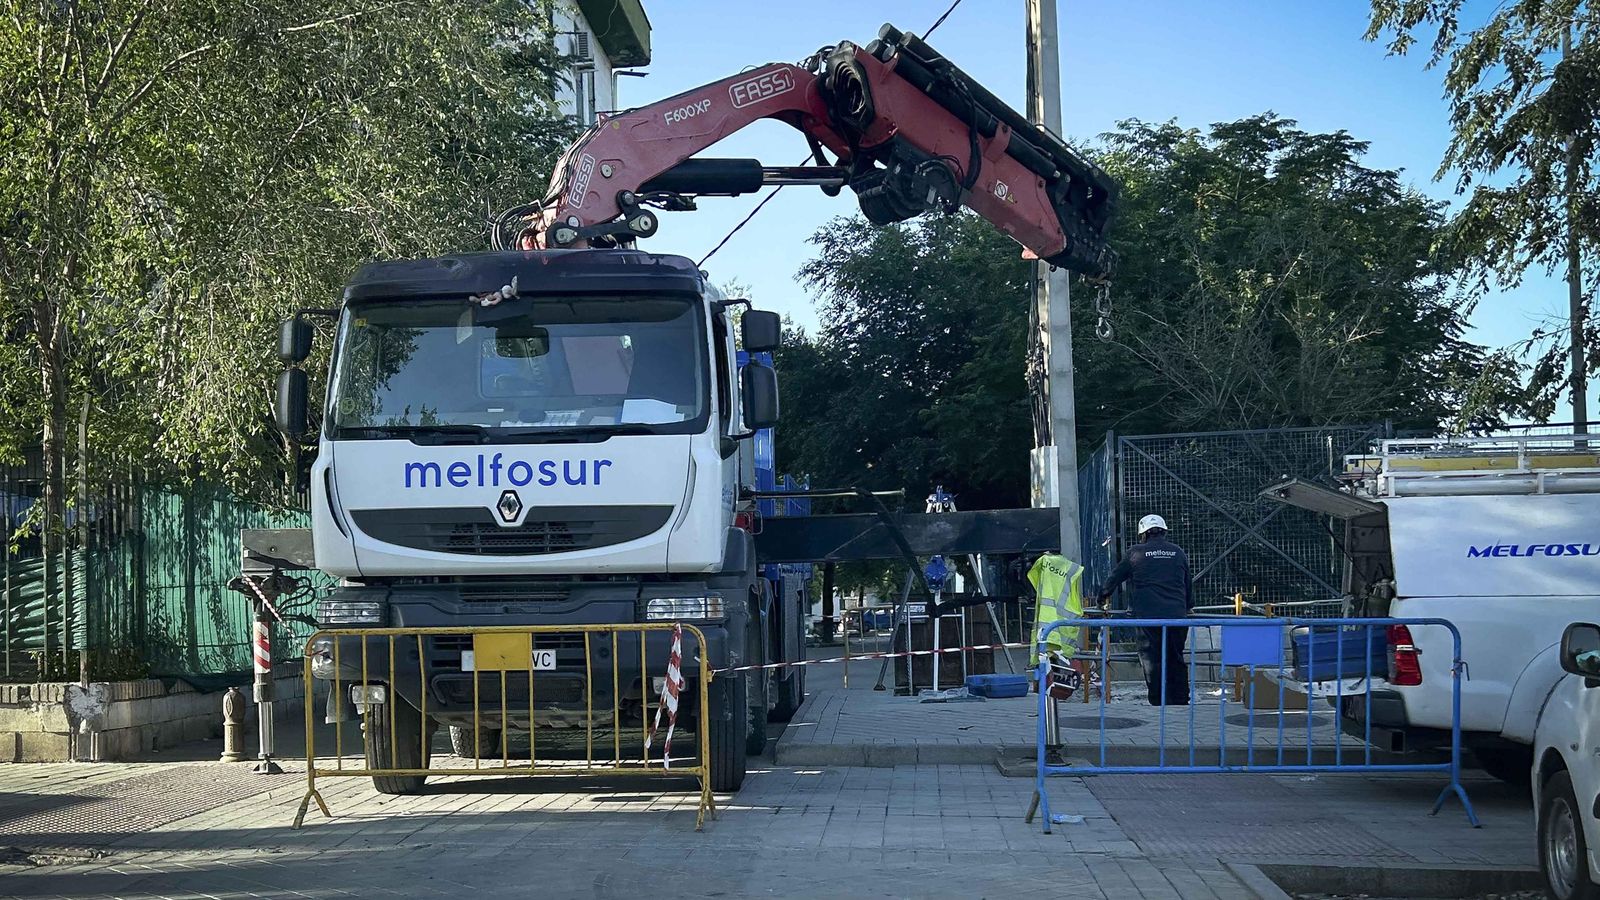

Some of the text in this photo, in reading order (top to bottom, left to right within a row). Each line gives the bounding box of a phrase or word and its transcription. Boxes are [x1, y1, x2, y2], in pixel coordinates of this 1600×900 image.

[733, 74, 792, 105] FASSI
[664, 99, 711, 125] F600XP
[572, 158, 593, 203] FASSI
[404, 453, 613, 488] melfosur
